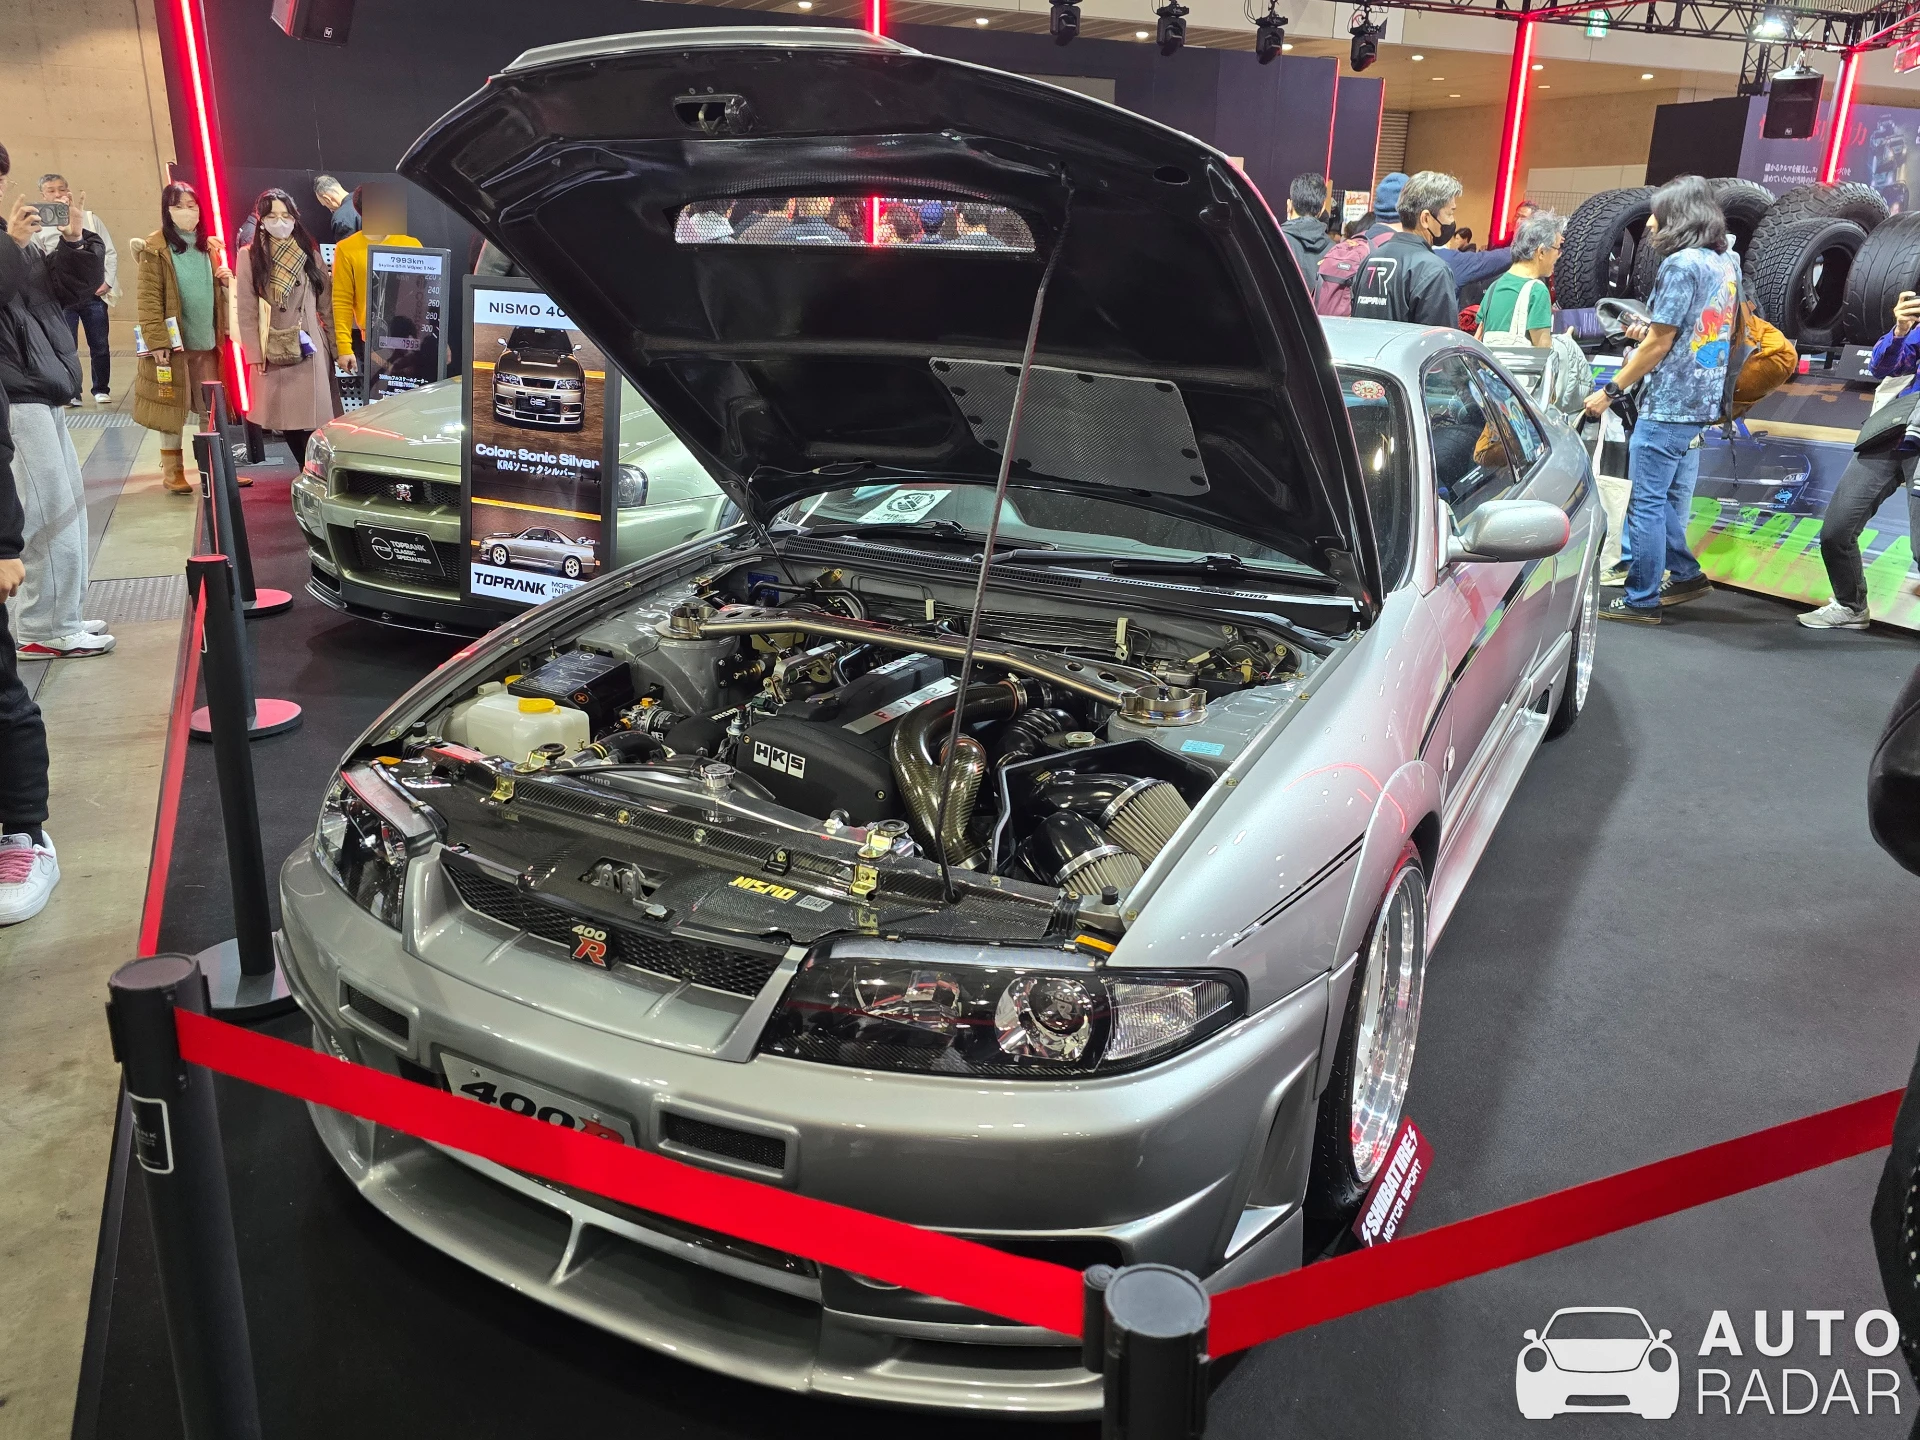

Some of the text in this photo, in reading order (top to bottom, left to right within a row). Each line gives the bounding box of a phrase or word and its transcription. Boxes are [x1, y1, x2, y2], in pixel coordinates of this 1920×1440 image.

[390, 256, 424, 265] 7993km
[427, 286, 440, 295] 240
[427, 299, 440, 308] 260
[488, 302, 541, 316] NISMO
[425, 312, 438, 320] 280
[420, 324, 433, 333] 300
[518, 448, 557, 464] Sonic
[558, 453, 600, 470] Silver
[496, 459, 576, 477] KR4ソニックシルバー
[389, 540, 427, 552] TOPRANK
[474, 571, 548, 596] TOPRANK
[551, 581, 574, 590] MORE
[755, 742, 804, 775] HKS
[727, 875, 798, 901] NISMO
[571, 924, 607, 941] 400
[572, 935, 607, 967] R
[1382, 1157, 1422, 1243] MOTOR SPORT
